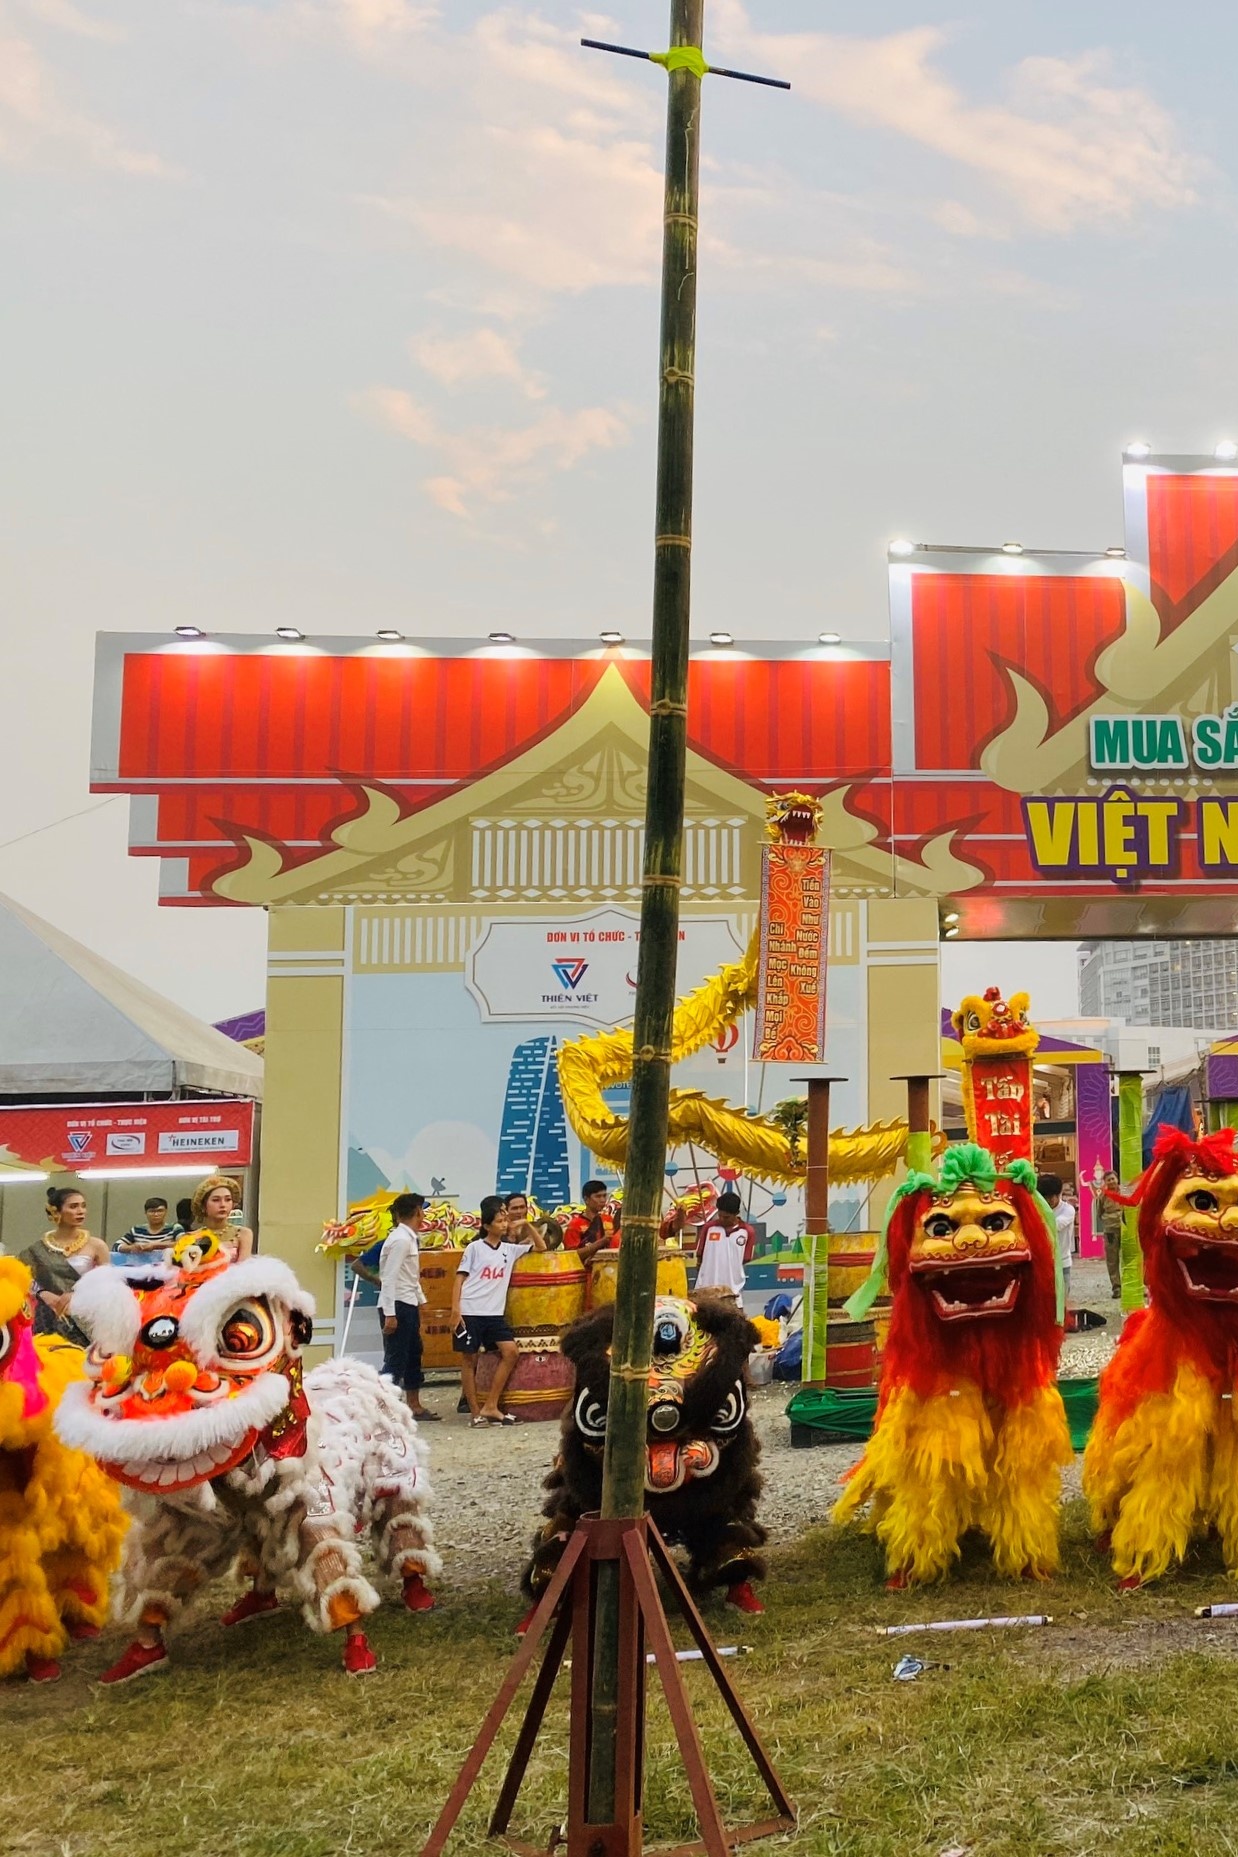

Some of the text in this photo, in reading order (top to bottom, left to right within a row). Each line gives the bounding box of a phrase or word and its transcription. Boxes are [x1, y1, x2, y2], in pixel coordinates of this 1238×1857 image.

[1095, 719, 1180, 764] MUA
[1026, 790, 1178, 878] VIỆT
[770, 923, 784, 934] Chi
[547, 930, 566, 942] ĐƠN
[570, 932, 579, 944] VỊ
[583, 928, 595, 942] TỔ
[598, 930, 625, 942] CHỨC
[796, 930, 818, 942] Nước
[769, 940, 796, 952] Nhánh
[768, 958, 788, 972] Mọc
[790, 964, 816, 978] Không
[768, 976, 782, 987] Lên
[542, 993, 598, 1002] THIÊN VIỆT
[765, 1010, 782, 1024] Mọi
[984, 1112, 1021, 1136] Tài
[172, 1137, 225, 1147] HEINEKEN
